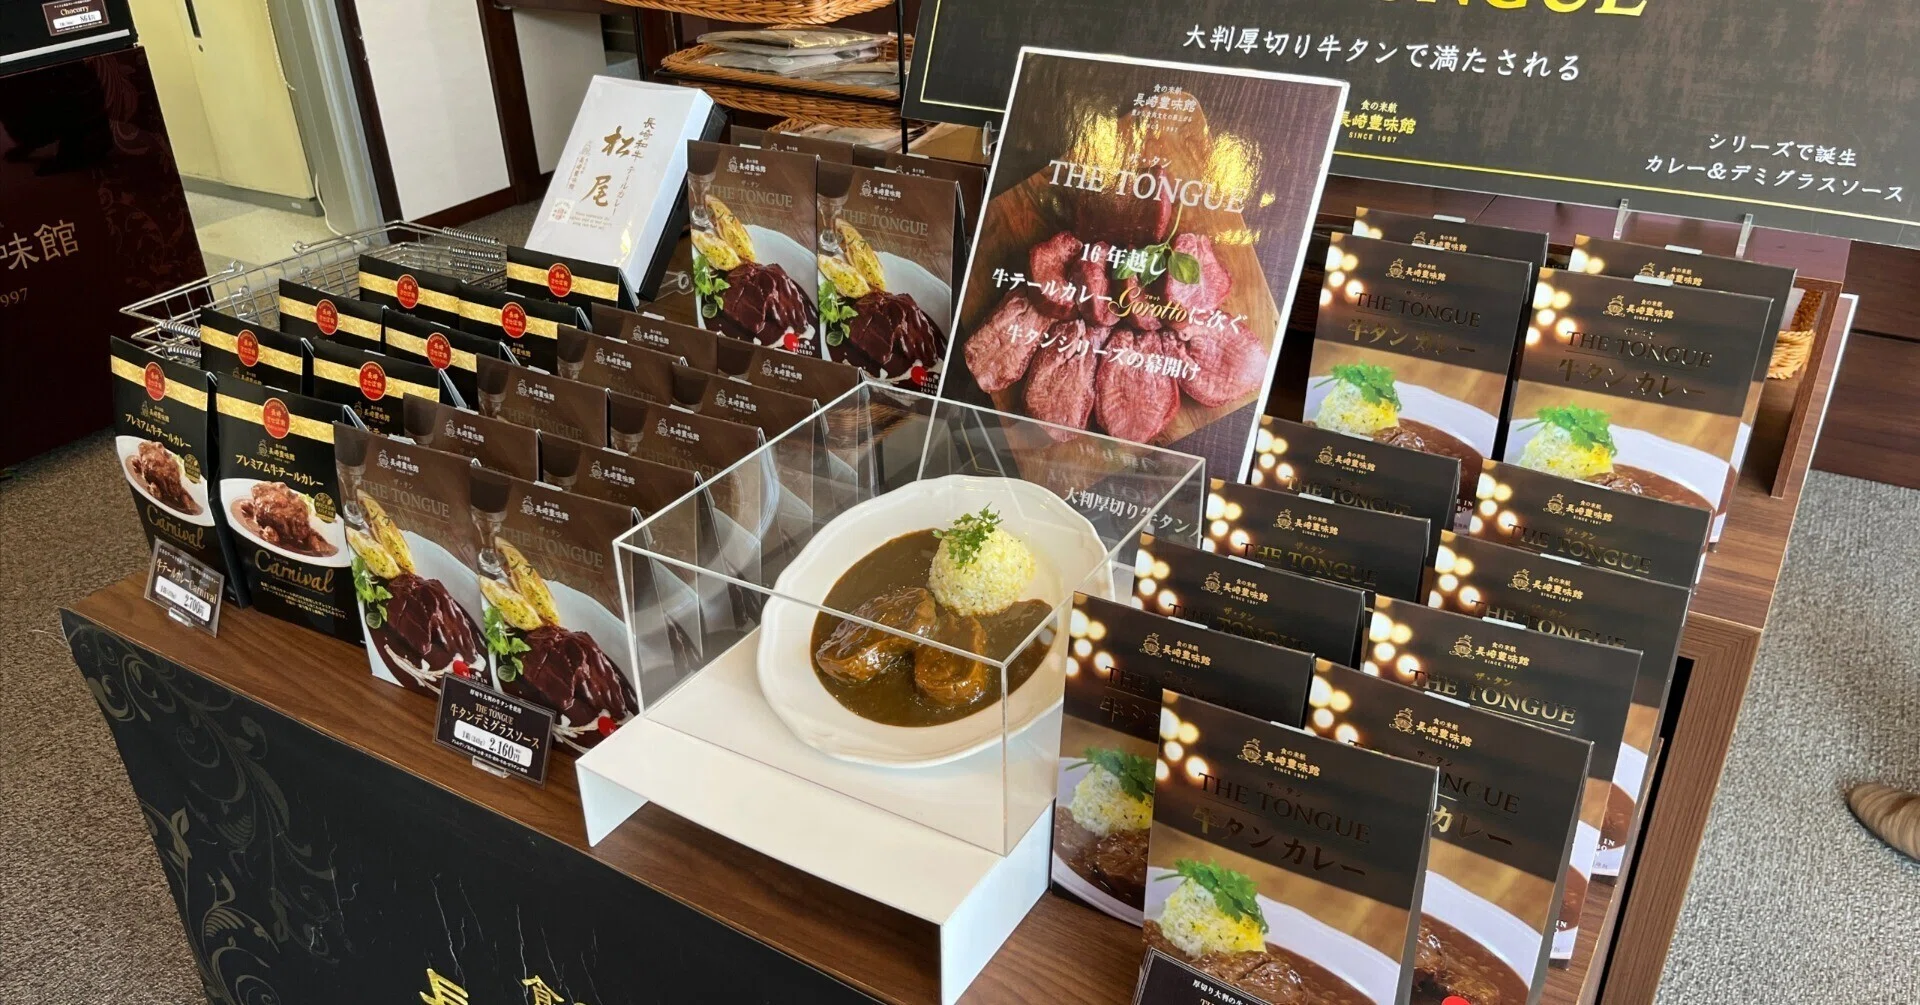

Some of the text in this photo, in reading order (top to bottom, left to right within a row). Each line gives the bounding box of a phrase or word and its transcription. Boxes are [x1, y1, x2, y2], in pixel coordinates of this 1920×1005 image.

[1183, 24, 1581, 82] 大判厚切り牛タンで満たされる
[1133, 92, 1197, 113] 長崎豊味館
[1341, 110, 1417, 135] 長崎豊味館
[1348, 131, 1397, 143] SINCE 1997
[1708, 133, 1858, 167] シリーズで誕生
[580, 125, 635, 207] 松尾
[1048, 159, 1249, 214] THE TONGUE
[740, 187, 793, 209] TONGUE
[871, 213, 929, 236] TONGUE
[992, 267, 1249, 335] 牛テールカレー Gorotto に次ぐ
[1355, 292, 1481, 328] THE TONGUE
[1006, 322, 1201, 382] 牛タンシリーズの幕開け
[1566, 330, 1713, 368] THE TONGUE
[235, 454, 324, 487] プレミアム牛テールカレー
[391, 487, 450, 518] TONGUE
[147, 504, 206, 550] Carnival
[1241, 542, 1377, 587] THE TONGUE
[1508, 523, 1653, 574] THE TONGUE
[255, 549, 335, 593] Carnival
[475, 703, 514, 726] THE TONGUE
[1408, 669, 1577, 725] THE TONGUE
[450, 703, 540, 750] 牛タンデミグラスソース
[1416, 721, 1472, 747] 長崎豊味館
[1264, 752, 1320, 777] 長崎豊味館
[1199, 773, 1372, 844] THE TONGUE
[1193, 806, 1366, 877] 牛タンカレー
